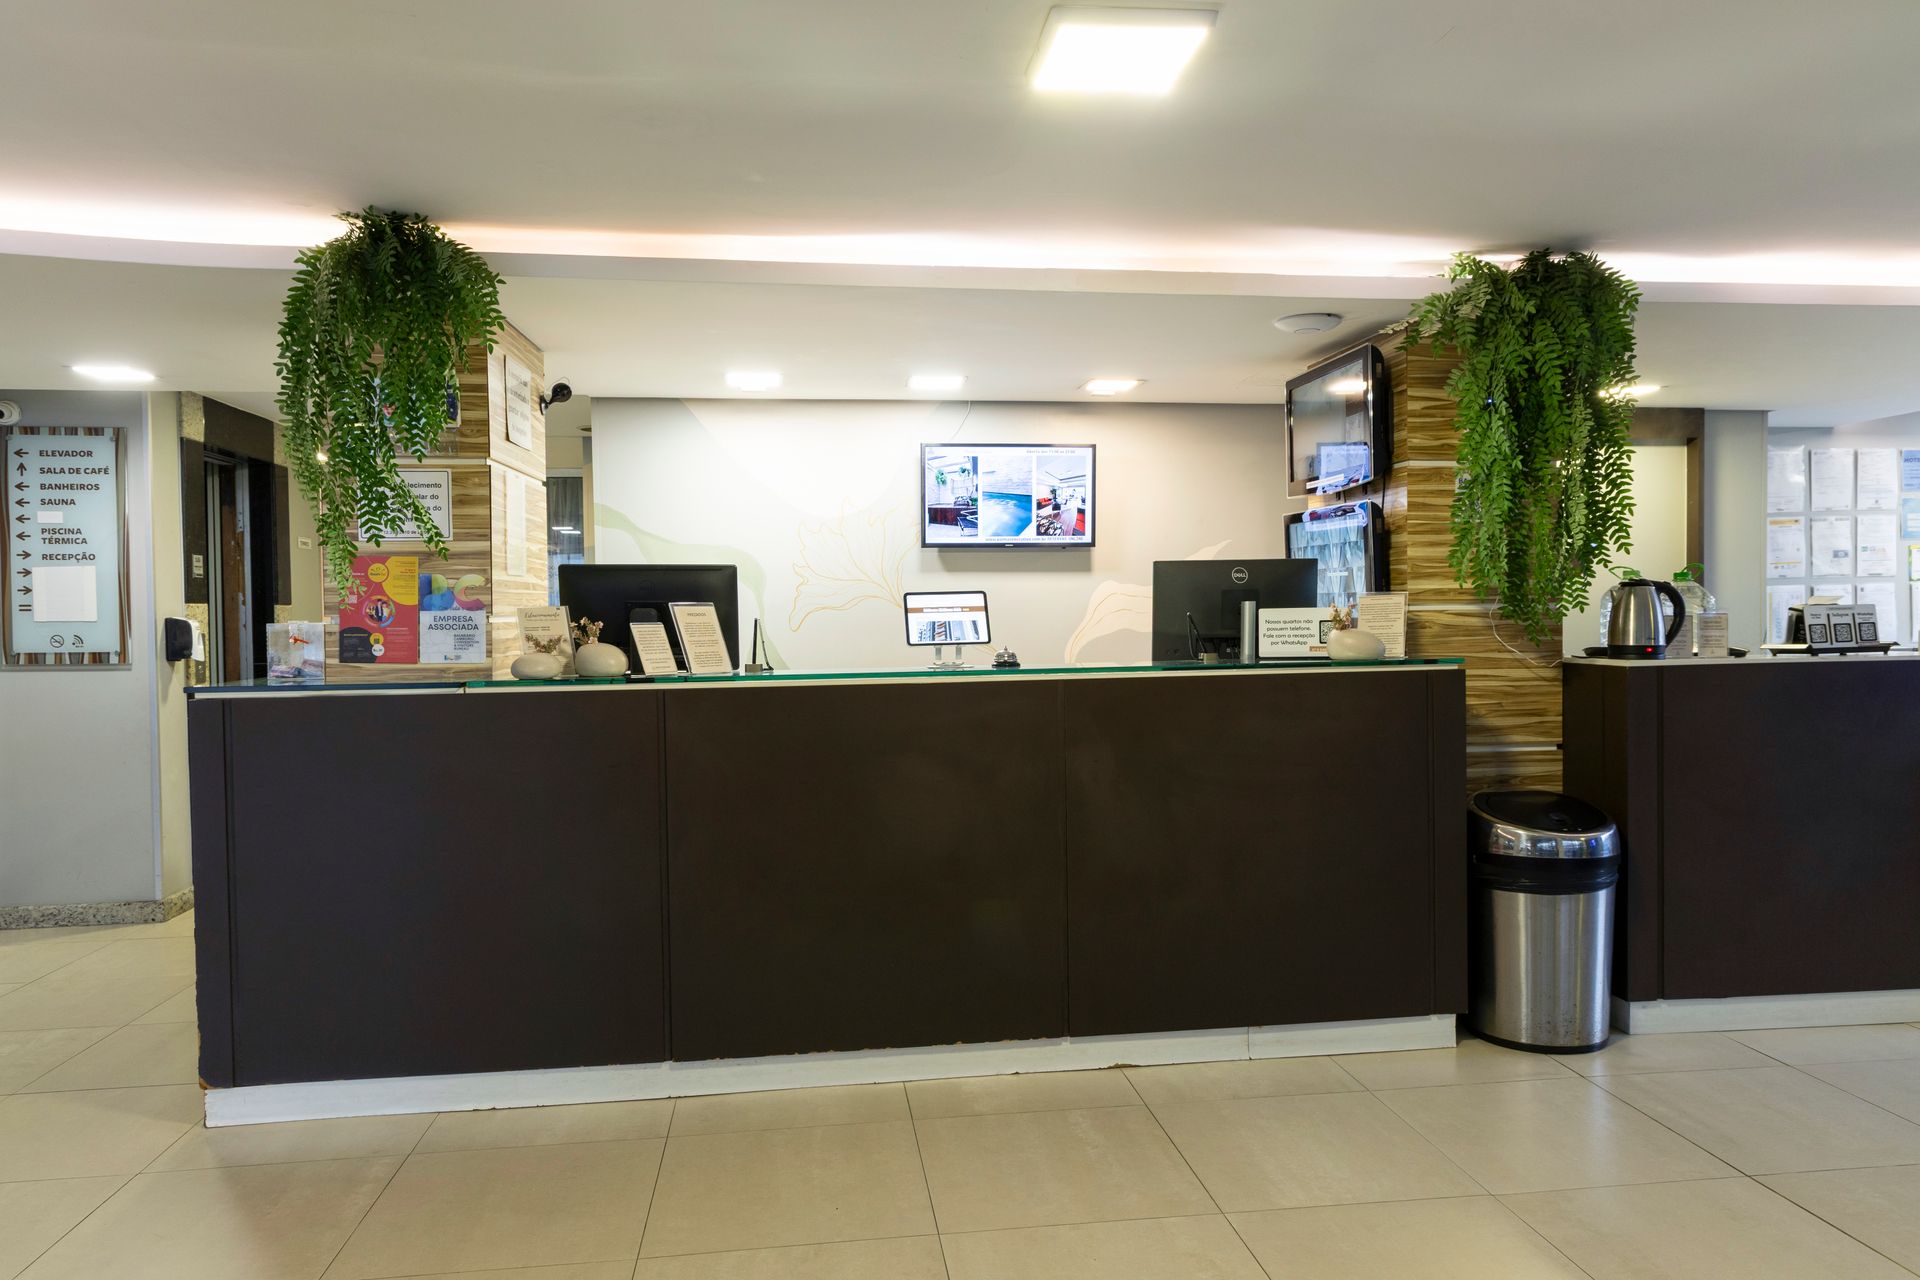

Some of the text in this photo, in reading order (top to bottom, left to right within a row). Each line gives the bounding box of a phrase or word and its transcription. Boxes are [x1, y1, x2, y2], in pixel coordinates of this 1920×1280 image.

[39, 449, 93, 457] ELEVADOR
[39, 465, 110, 475] SALA DE CAFÉ
[40, 483, 100, 491] BANHEIROS
[40, 498, 76, 506] SAUNA
[41, 535, 88, 545] TÉRMICA
[41, 552, 96, 562] RECEPÇÃO
[433, 615, 474, 623] EMPRESA
[428, 623, 479, 631] ASSOCIADA
